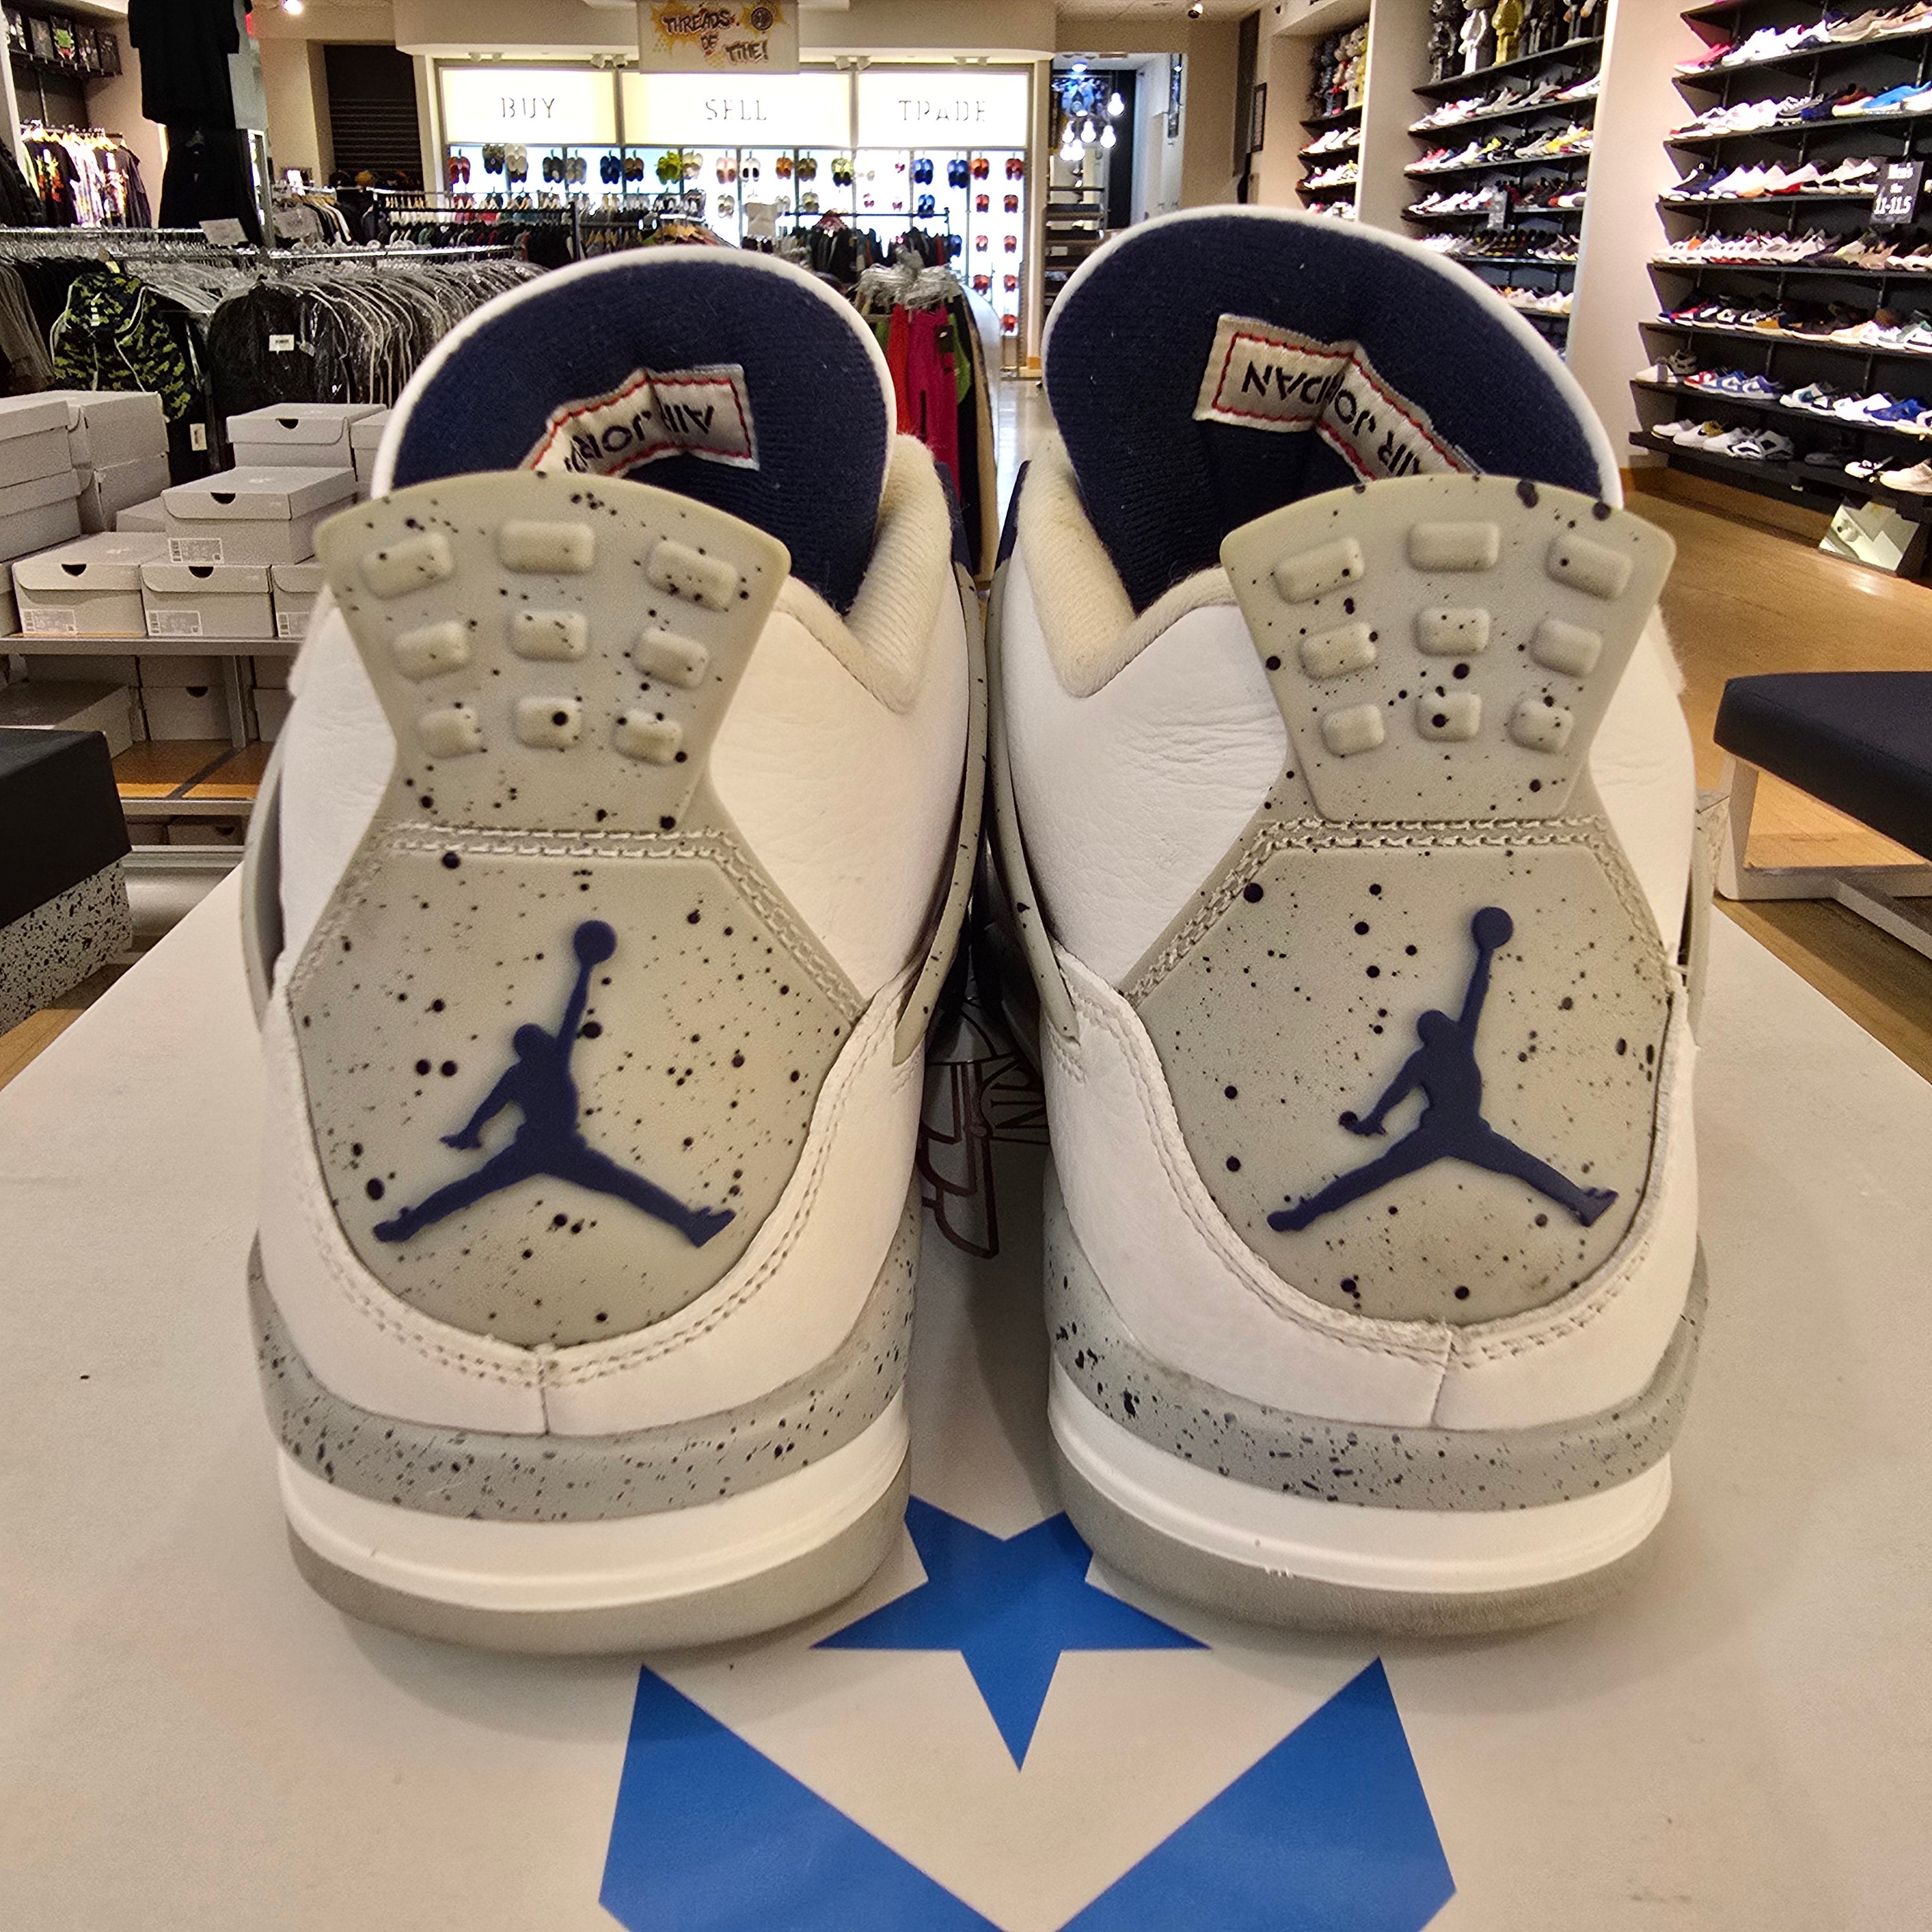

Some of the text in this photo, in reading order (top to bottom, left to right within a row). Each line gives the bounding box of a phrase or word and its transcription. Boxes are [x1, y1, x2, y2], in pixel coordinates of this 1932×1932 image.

[663, 9, 731, 33] THREADS
[500, 97, 555, 119] BUY
[705, 99, 767, 121] SELL
[898, 99, 985, 121] TRADE
